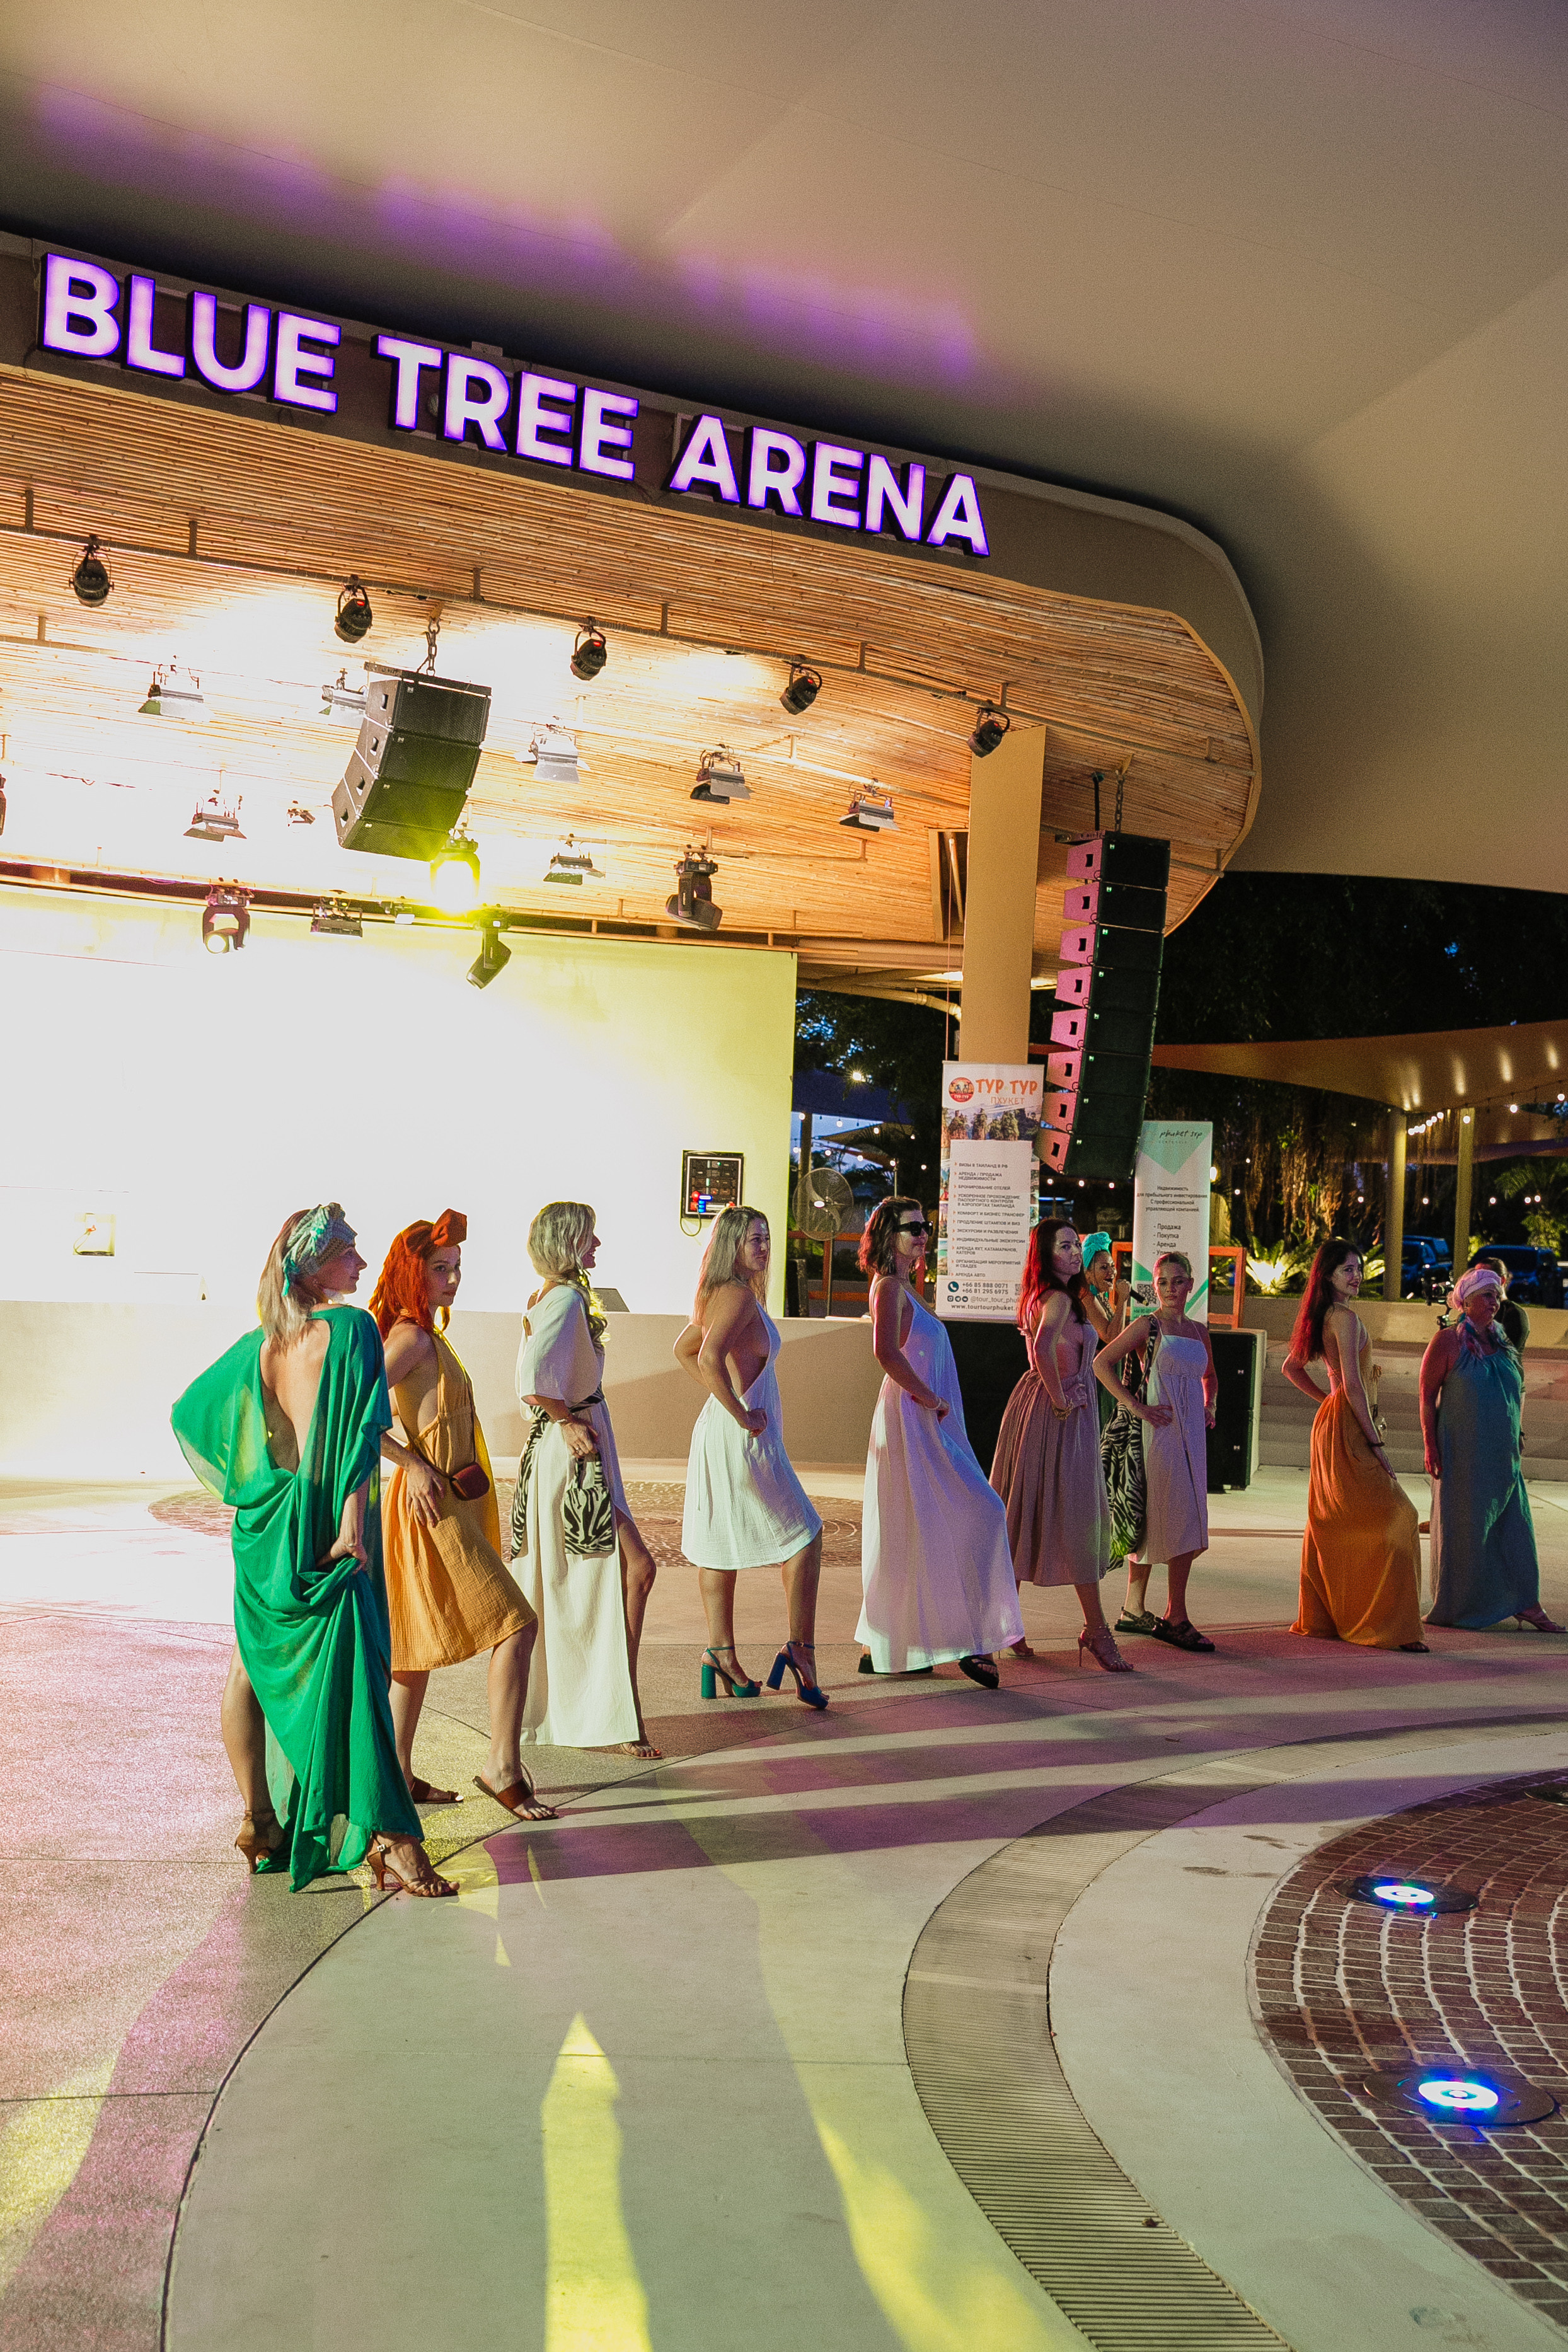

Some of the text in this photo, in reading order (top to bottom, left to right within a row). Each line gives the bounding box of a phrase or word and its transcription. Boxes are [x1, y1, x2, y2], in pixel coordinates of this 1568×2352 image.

[43, 253, 990, 556] BLUE TREE ARENA
[976, 1078, 1038, 1095] ТУР ТУР
[991, 1097, 1025, 1105] ПХУКЕТ
